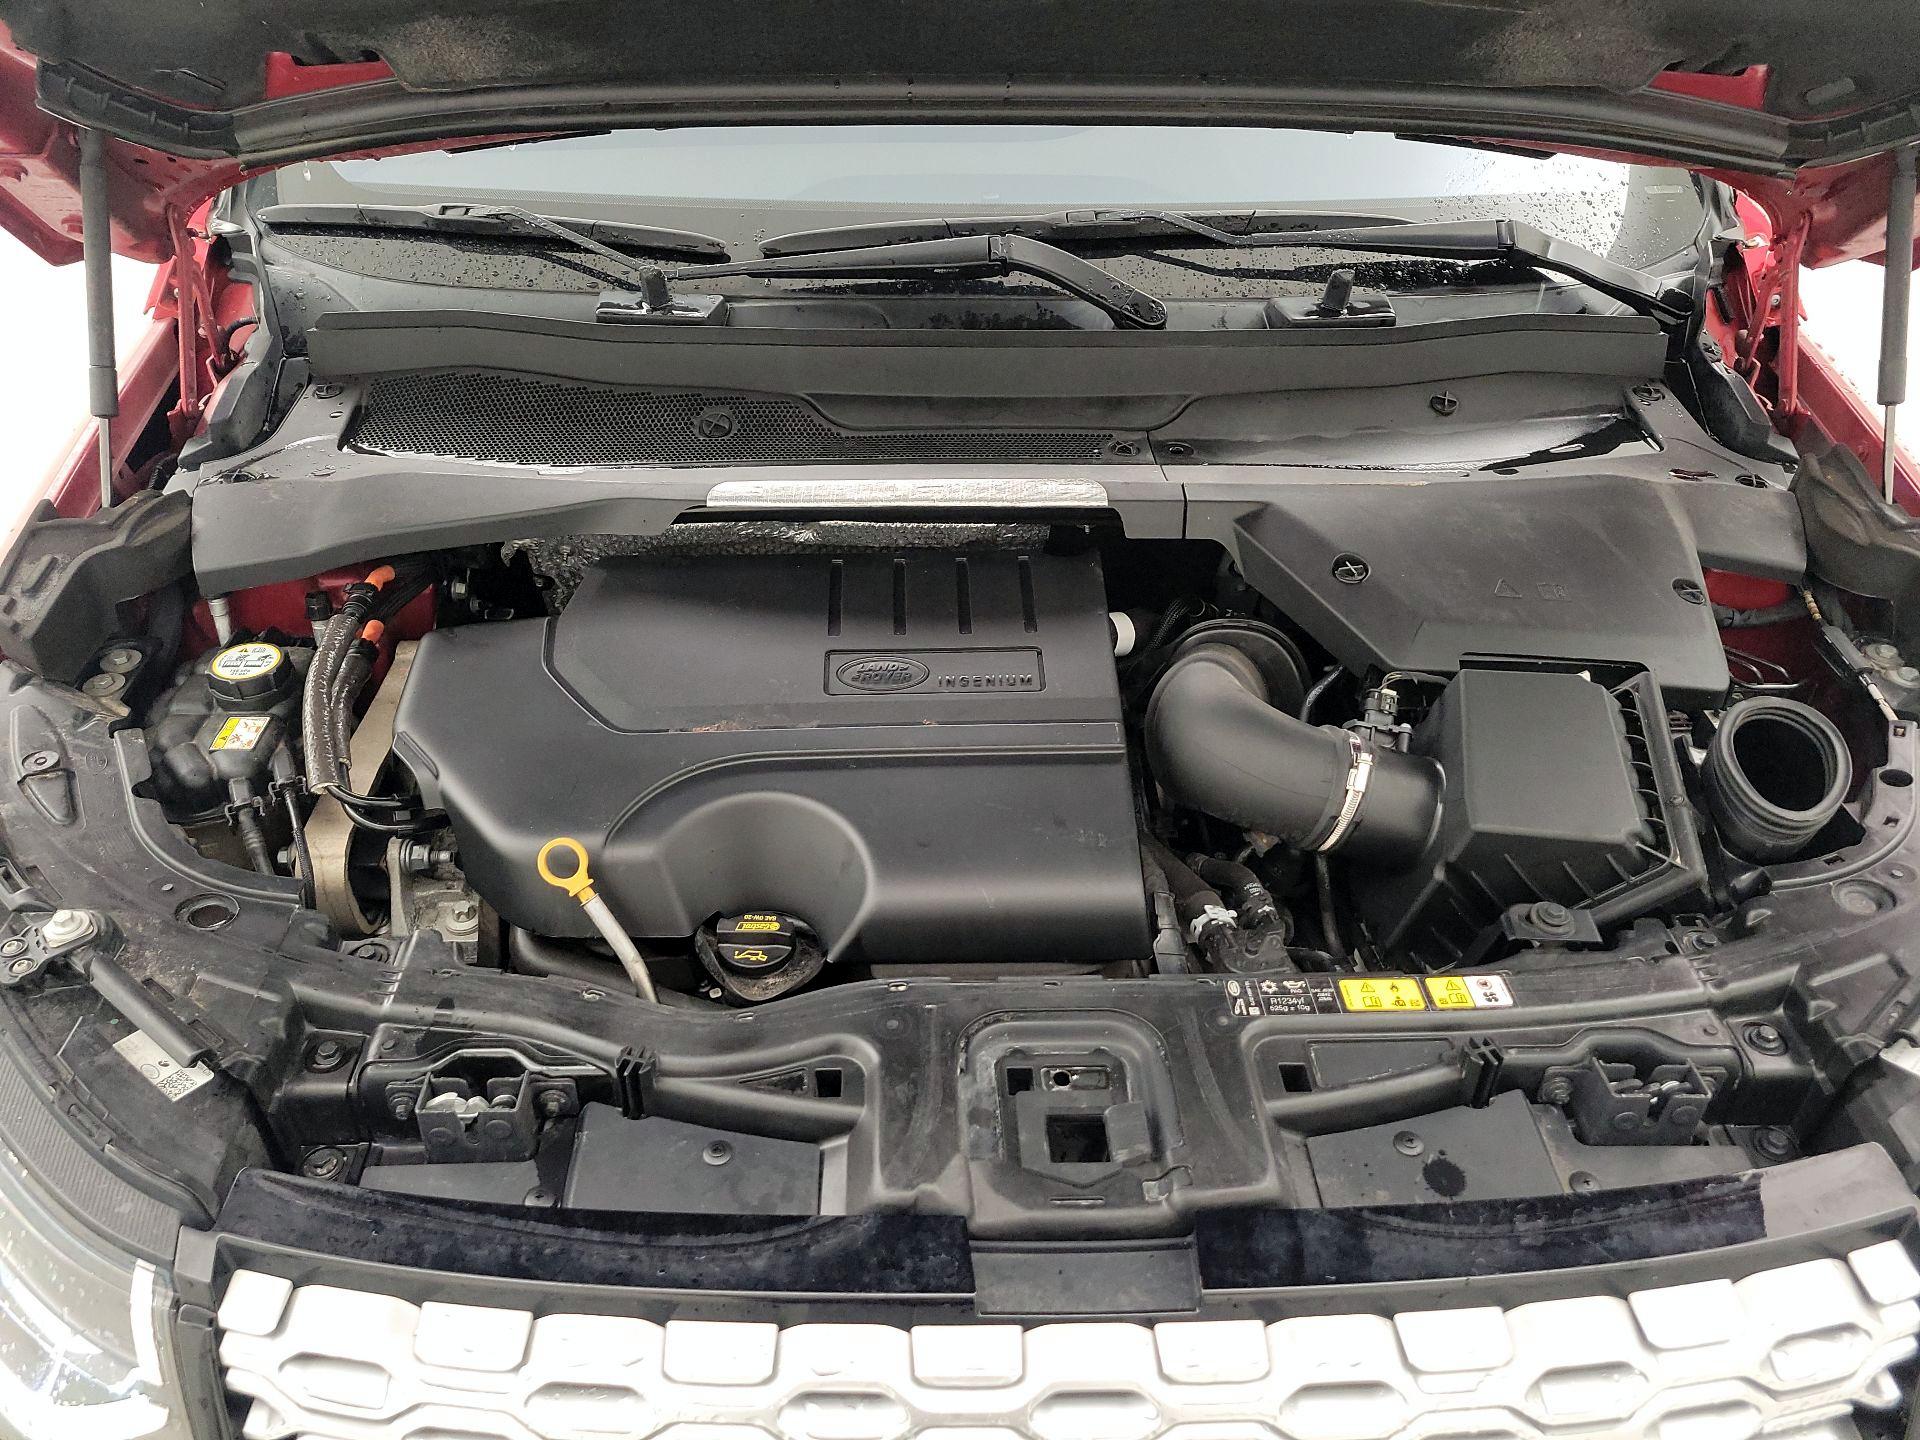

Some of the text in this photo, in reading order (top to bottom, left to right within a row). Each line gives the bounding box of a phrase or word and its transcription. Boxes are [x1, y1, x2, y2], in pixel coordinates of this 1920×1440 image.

[856, 662, 899, 672] LAND
[860, 672, 912, 684] ROVER
[938, 674, 1033, 687] INGENIUM
[1270, 997, 1304, 1005] R1234yf
